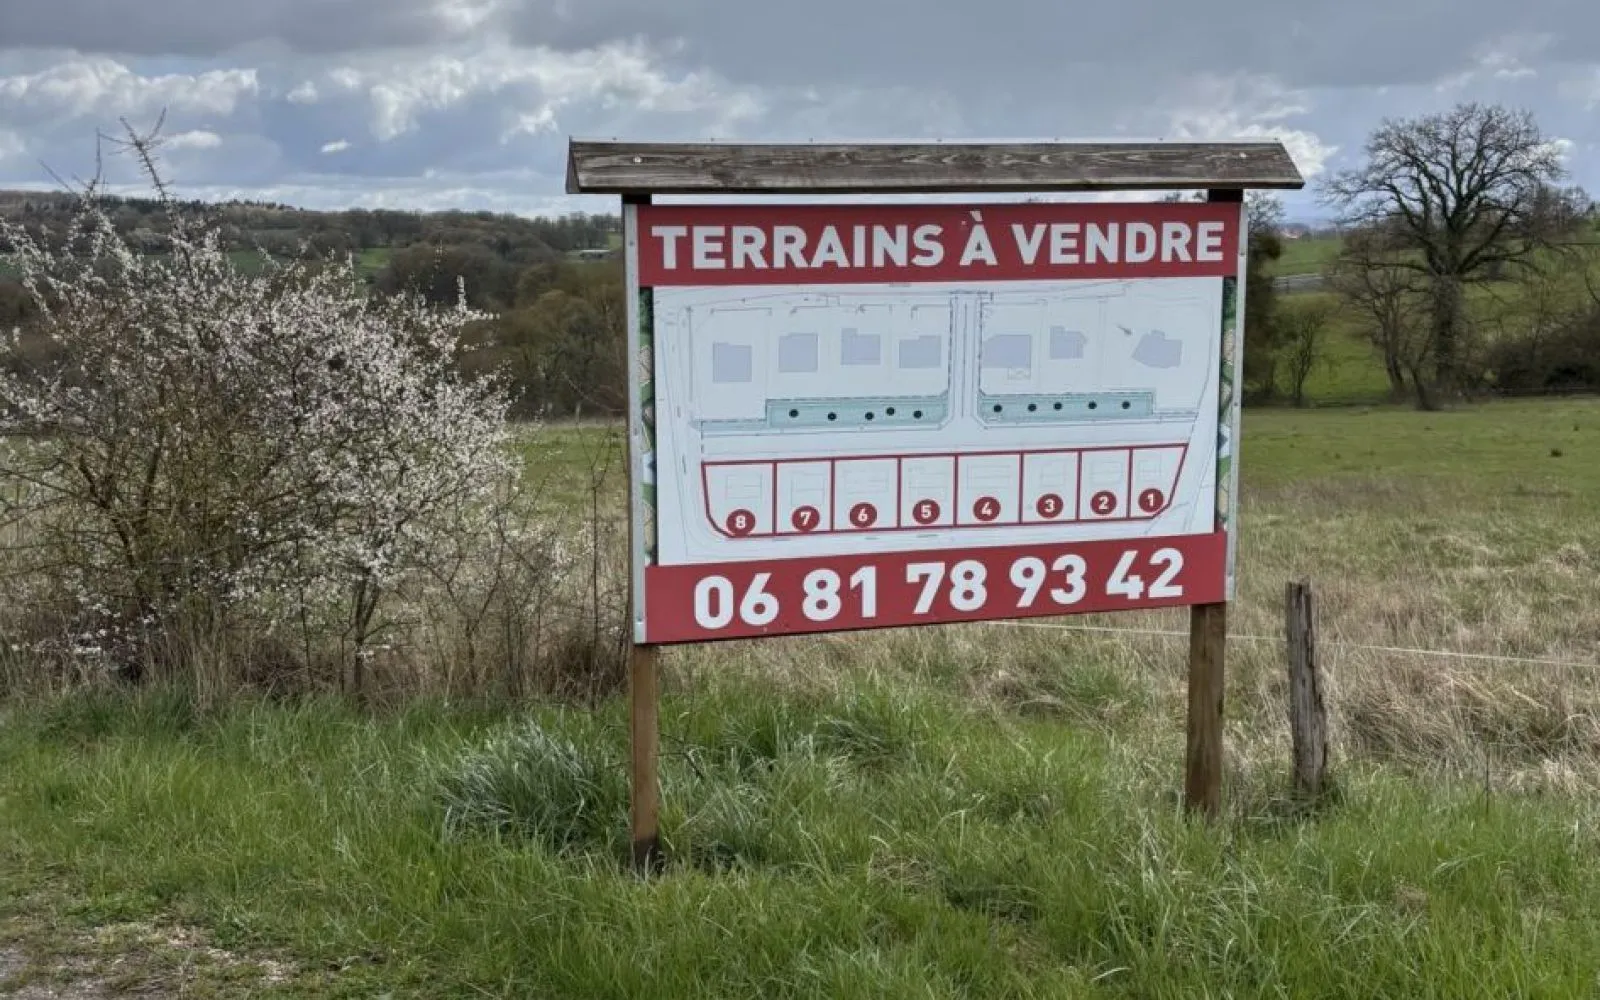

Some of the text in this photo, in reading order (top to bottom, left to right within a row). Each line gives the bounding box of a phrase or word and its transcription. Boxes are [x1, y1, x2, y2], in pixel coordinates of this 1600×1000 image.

[651, 211, 1225, 270] TERRAINS À VENDRE
[694, 547, 1184, 629] 06 81 78 93 42
